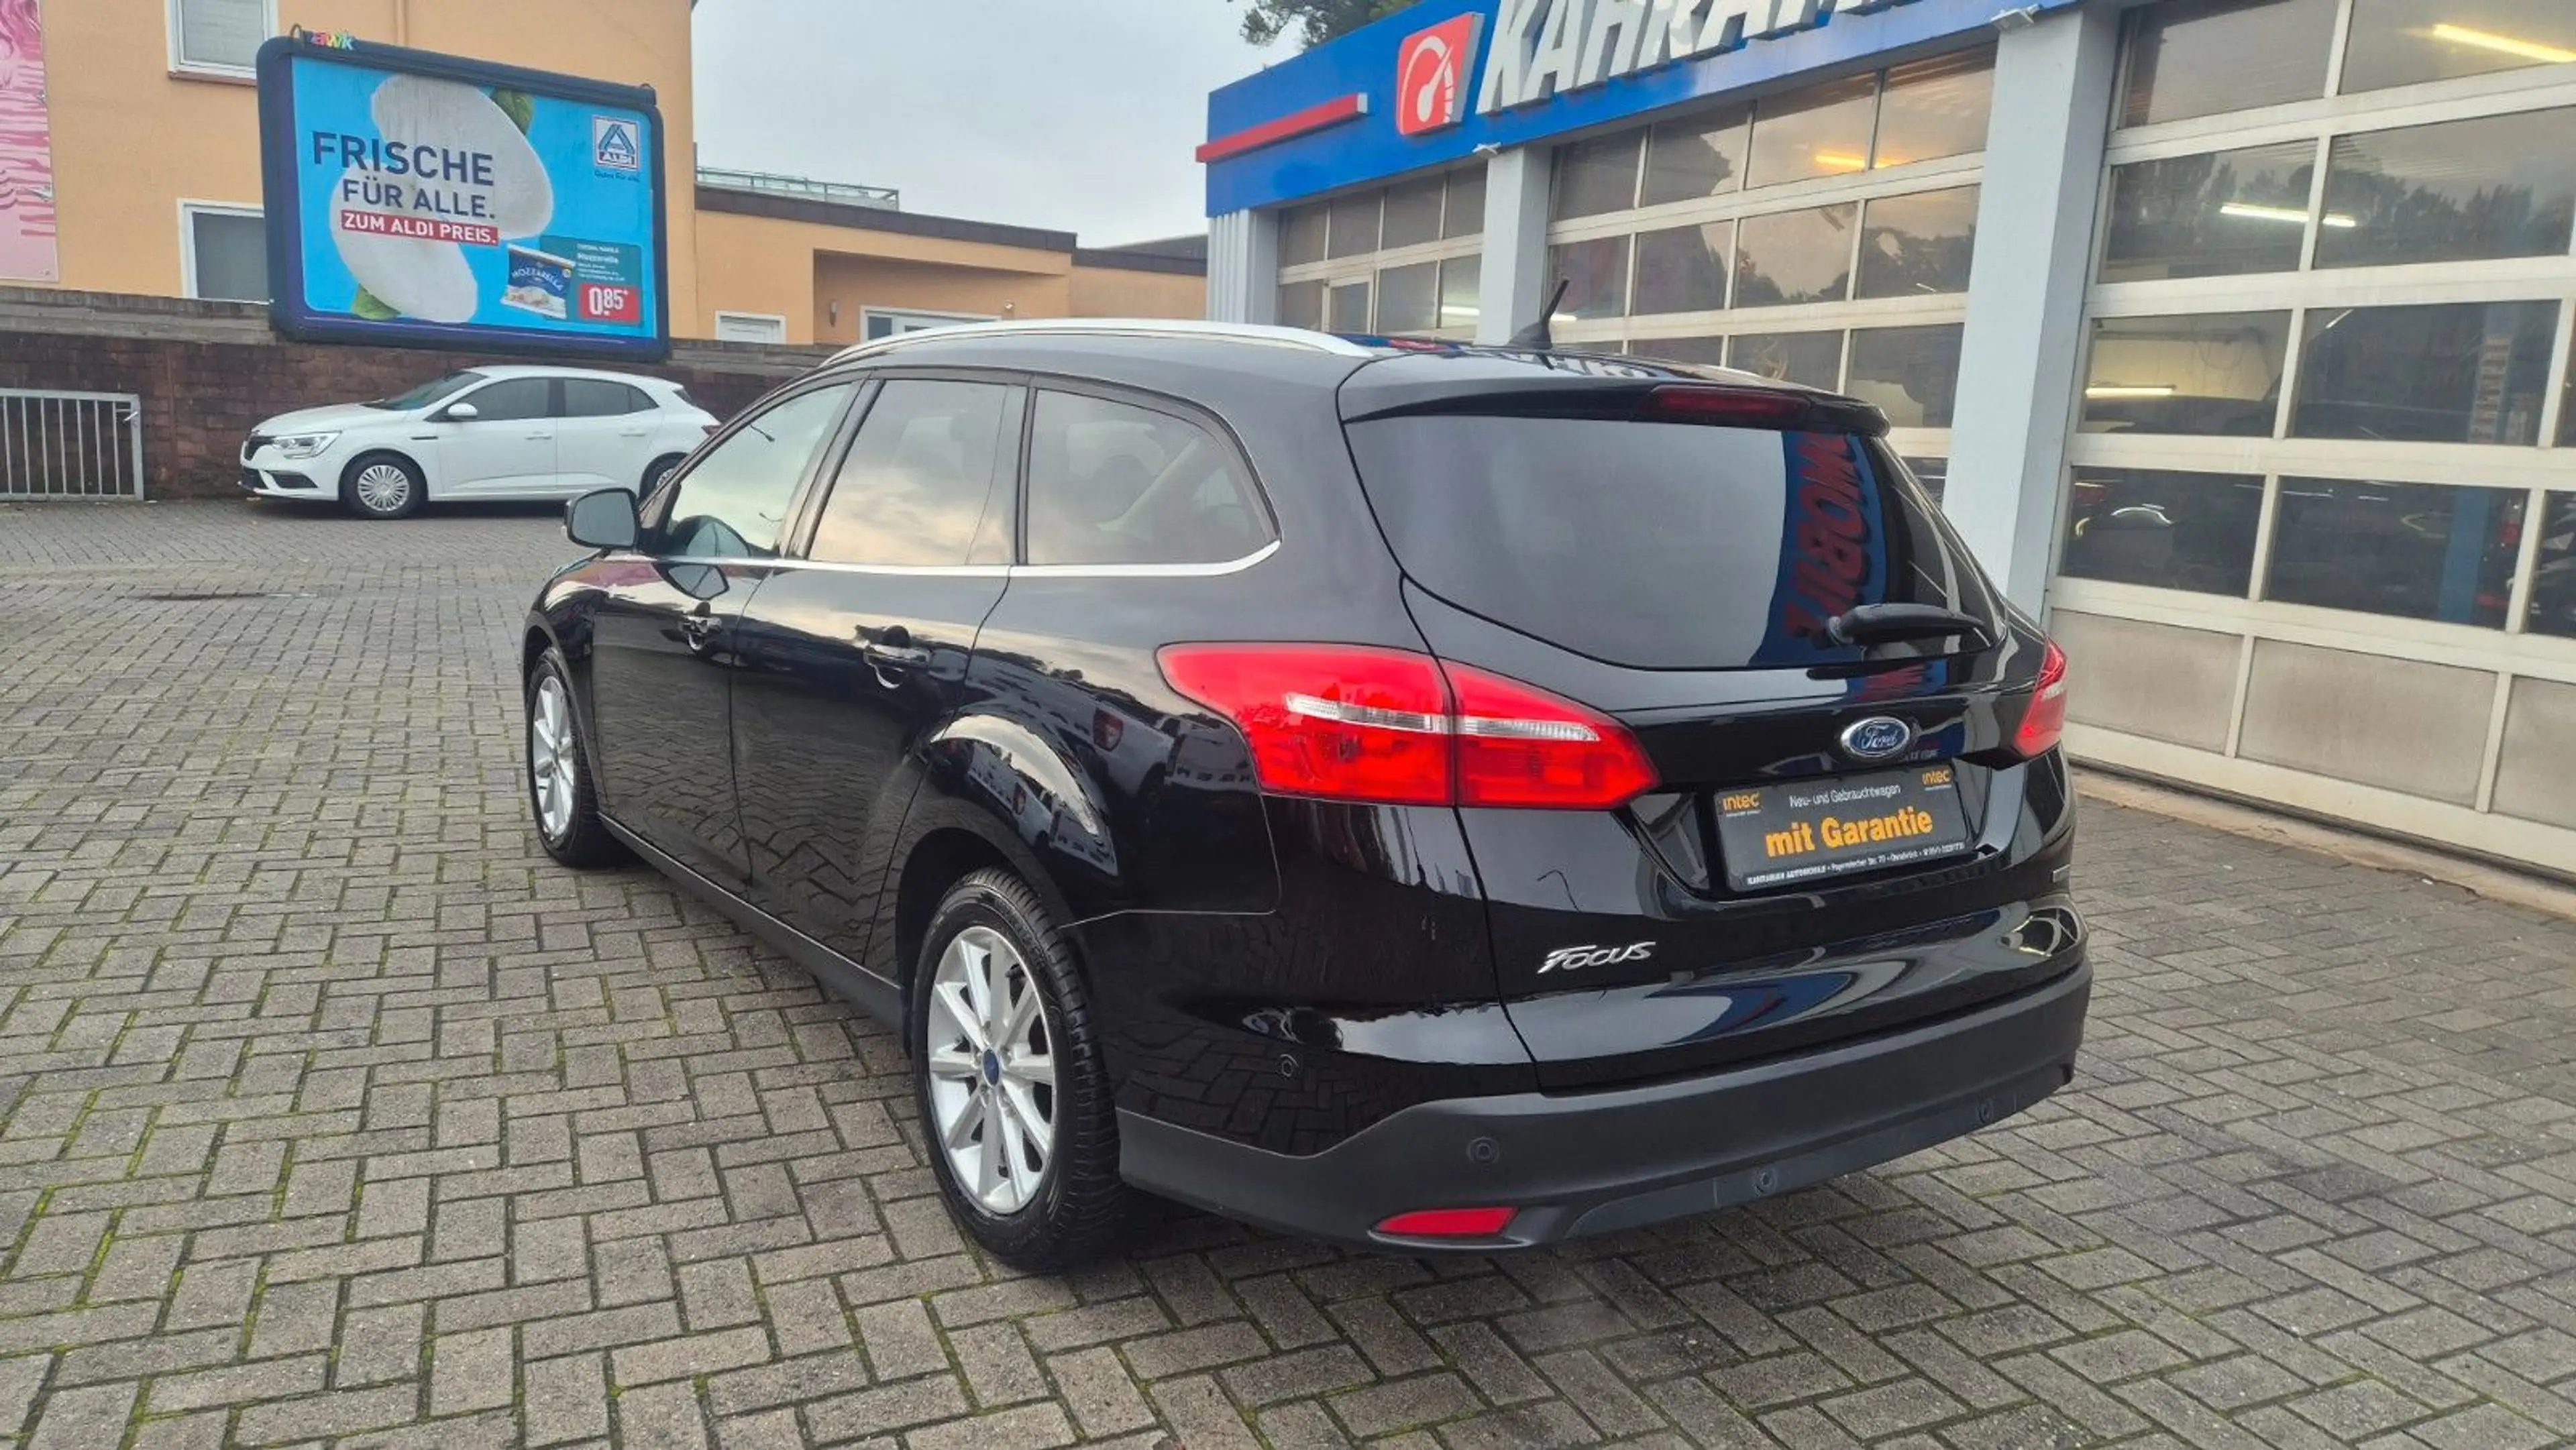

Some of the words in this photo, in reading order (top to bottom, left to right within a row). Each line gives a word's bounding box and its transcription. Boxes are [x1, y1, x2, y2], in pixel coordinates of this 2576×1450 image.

[313, 131, 494, 186] FRISCHE
[343, 176, 402, 208] FÜR
[413, 188, 496, 219] ALLE.
[344, 213, 384, 231] ZUM
[391, 219, 434, 237] ALDI
[440, 225, 496, 243] PREIS.
[1861, 724, 1899, 750] Ford
[1788, 795, 1811, 807] Neu-
[1813, 793, 1829, 805] und
[1766, 822, 1815, 857] mit
[1821, 806, 1933, 848] Garantie
